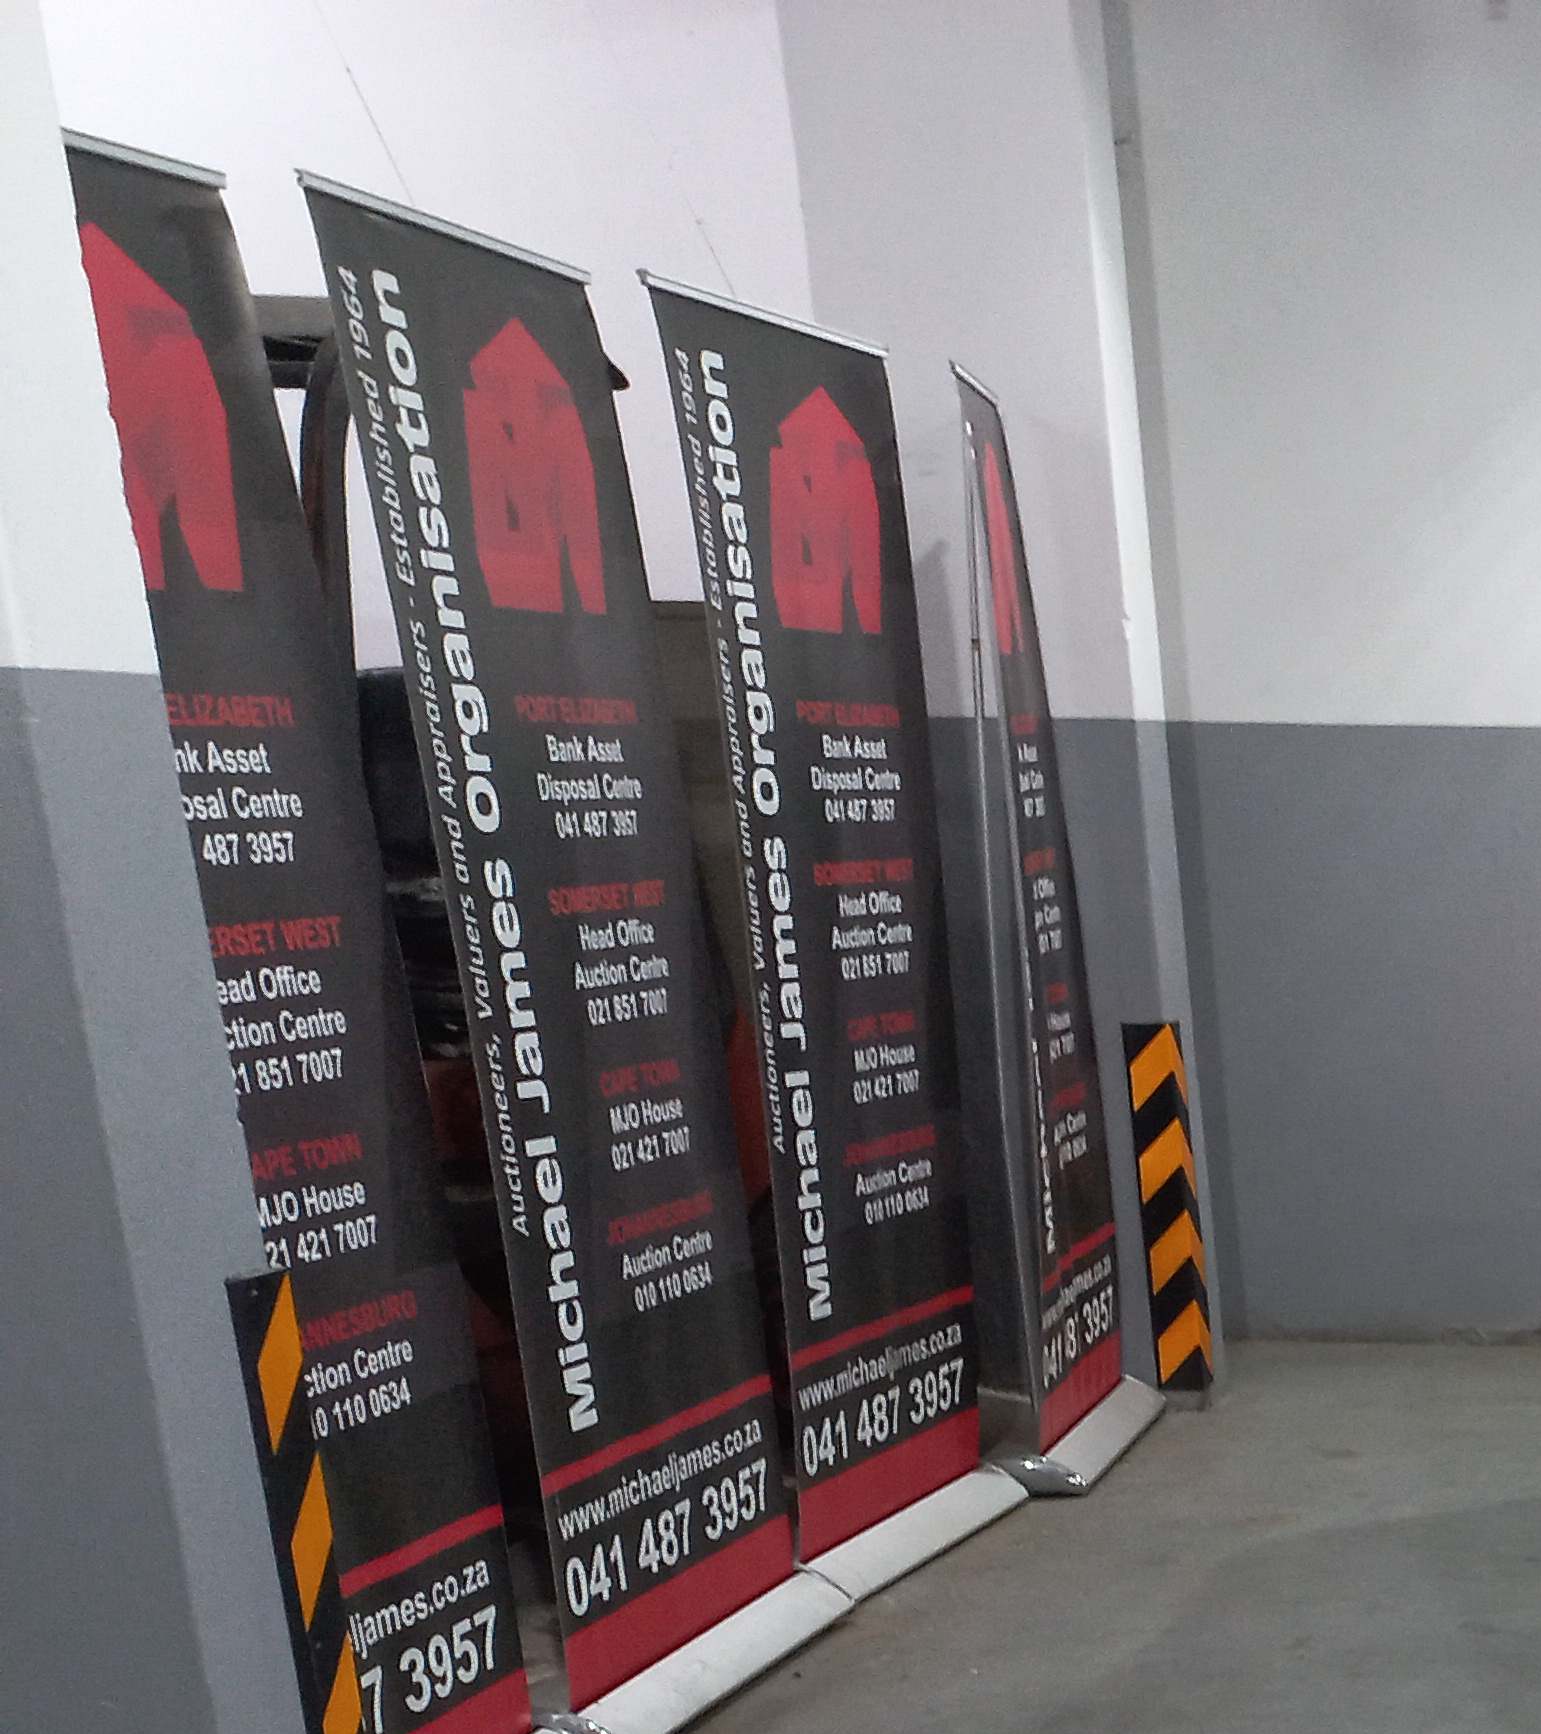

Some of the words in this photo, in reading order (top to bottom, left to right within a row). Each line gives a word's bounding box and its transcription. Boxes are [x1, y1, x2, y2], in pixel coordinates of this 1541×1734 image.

[337, 265, 372, 360] 1964
[675, 347, 698, 425] 1964
[358, 369, 416, 587] Established
[372, 269, 501, 833] Organisation
[687, 433, 723, 611] Established
[700, 350, 780, 816] Organisation
[409, 621, 457, 808] Appraisers
[717, 638, 747, 794] Appraisers
[175, 740, 203, 773] nk
[207, 740, 271, 773] Asset
[545, 733, 585, 762] Bank
[587, 735, 625, 762] Asset
[181, 787, 228, 820] osal
[232, 787, 303, 819] Centre
[536, 773, 600, 806] Disposal
[602, 773, 643, 800] Centre
[203, 834, 239, 865] 487
[246, 831, 294, 864] 3957
[441, 814, 471, 885] and
[555, 811, 581, 839] 041
[583, 810, 608, 838] 487
[738, 800, 754, 858] and
[280, 916, 342, 950] WEST
[459, 893, 493, 1018] Valuers
[578, 920, 615, 951] Head
[616, 918, 655, 947] Office
[764, 836, 807, 1052] James
[216, 970, 257, 1005] ead
[259, 965, 321, 1000] Office
[484, 859, 551, 1113] James
[574, 960, 628, 990] Auction
[629, 954, 670, 982] Centre
[279, 1008, 347, 1041] Centre
[587, 997, 612, 1027] 021
[255, 1056, 294, 1090] 851
[296, 1047, 342, 1084] 7007
[486, 1034, 529, 1236] Auctioneers,
[641, 1098, 683, 1126] House
[252, 1145, 297, 1180] APE
[298, 1132, 364, 1169] TOWN
[611, 1142, 635, 1171] 021
[637, 1133, 661, 1163] 421
[662, 1126, 690, 1156] 7007
[302, 1182, 366, 1218] House
[785, 1070, 832, 1321] Michael
[265, 1238, 292, 1269] 21
[297, 1228, 332, 1263] 421
[333, 1215, 376, 1253] 7007
[622, 1243, 672, 1280] Auction
[672, 1230, 713, 1262] Centre
[525, 1135, 599, 1432] Michael
[634, 1281, 657, 1312] 010
[658, 1272, 681, 1302] 110
[353, 1340, 413, 1378] Centre
[311, 1407, 328, 1440] 10
[332, 1394, 367, 1430] 110
[368, 1376, 412, 1417] 0634
[803, 1410, 849, 1476] 041
[857, 1385, 900, 1447] 487
[909, 1357, 964, 1424] 3957
[557, 1418, 762, 1541] www.michaeljames.co.za
[565, 1534, 628, 1617] 041
[638, 1498, 691, 1574] 487
[702, 1457, 767, 1541] 3957
[349, 1560, 489, 1660] ljames.co.za
[400, 1604, 496, 1712] 3957
